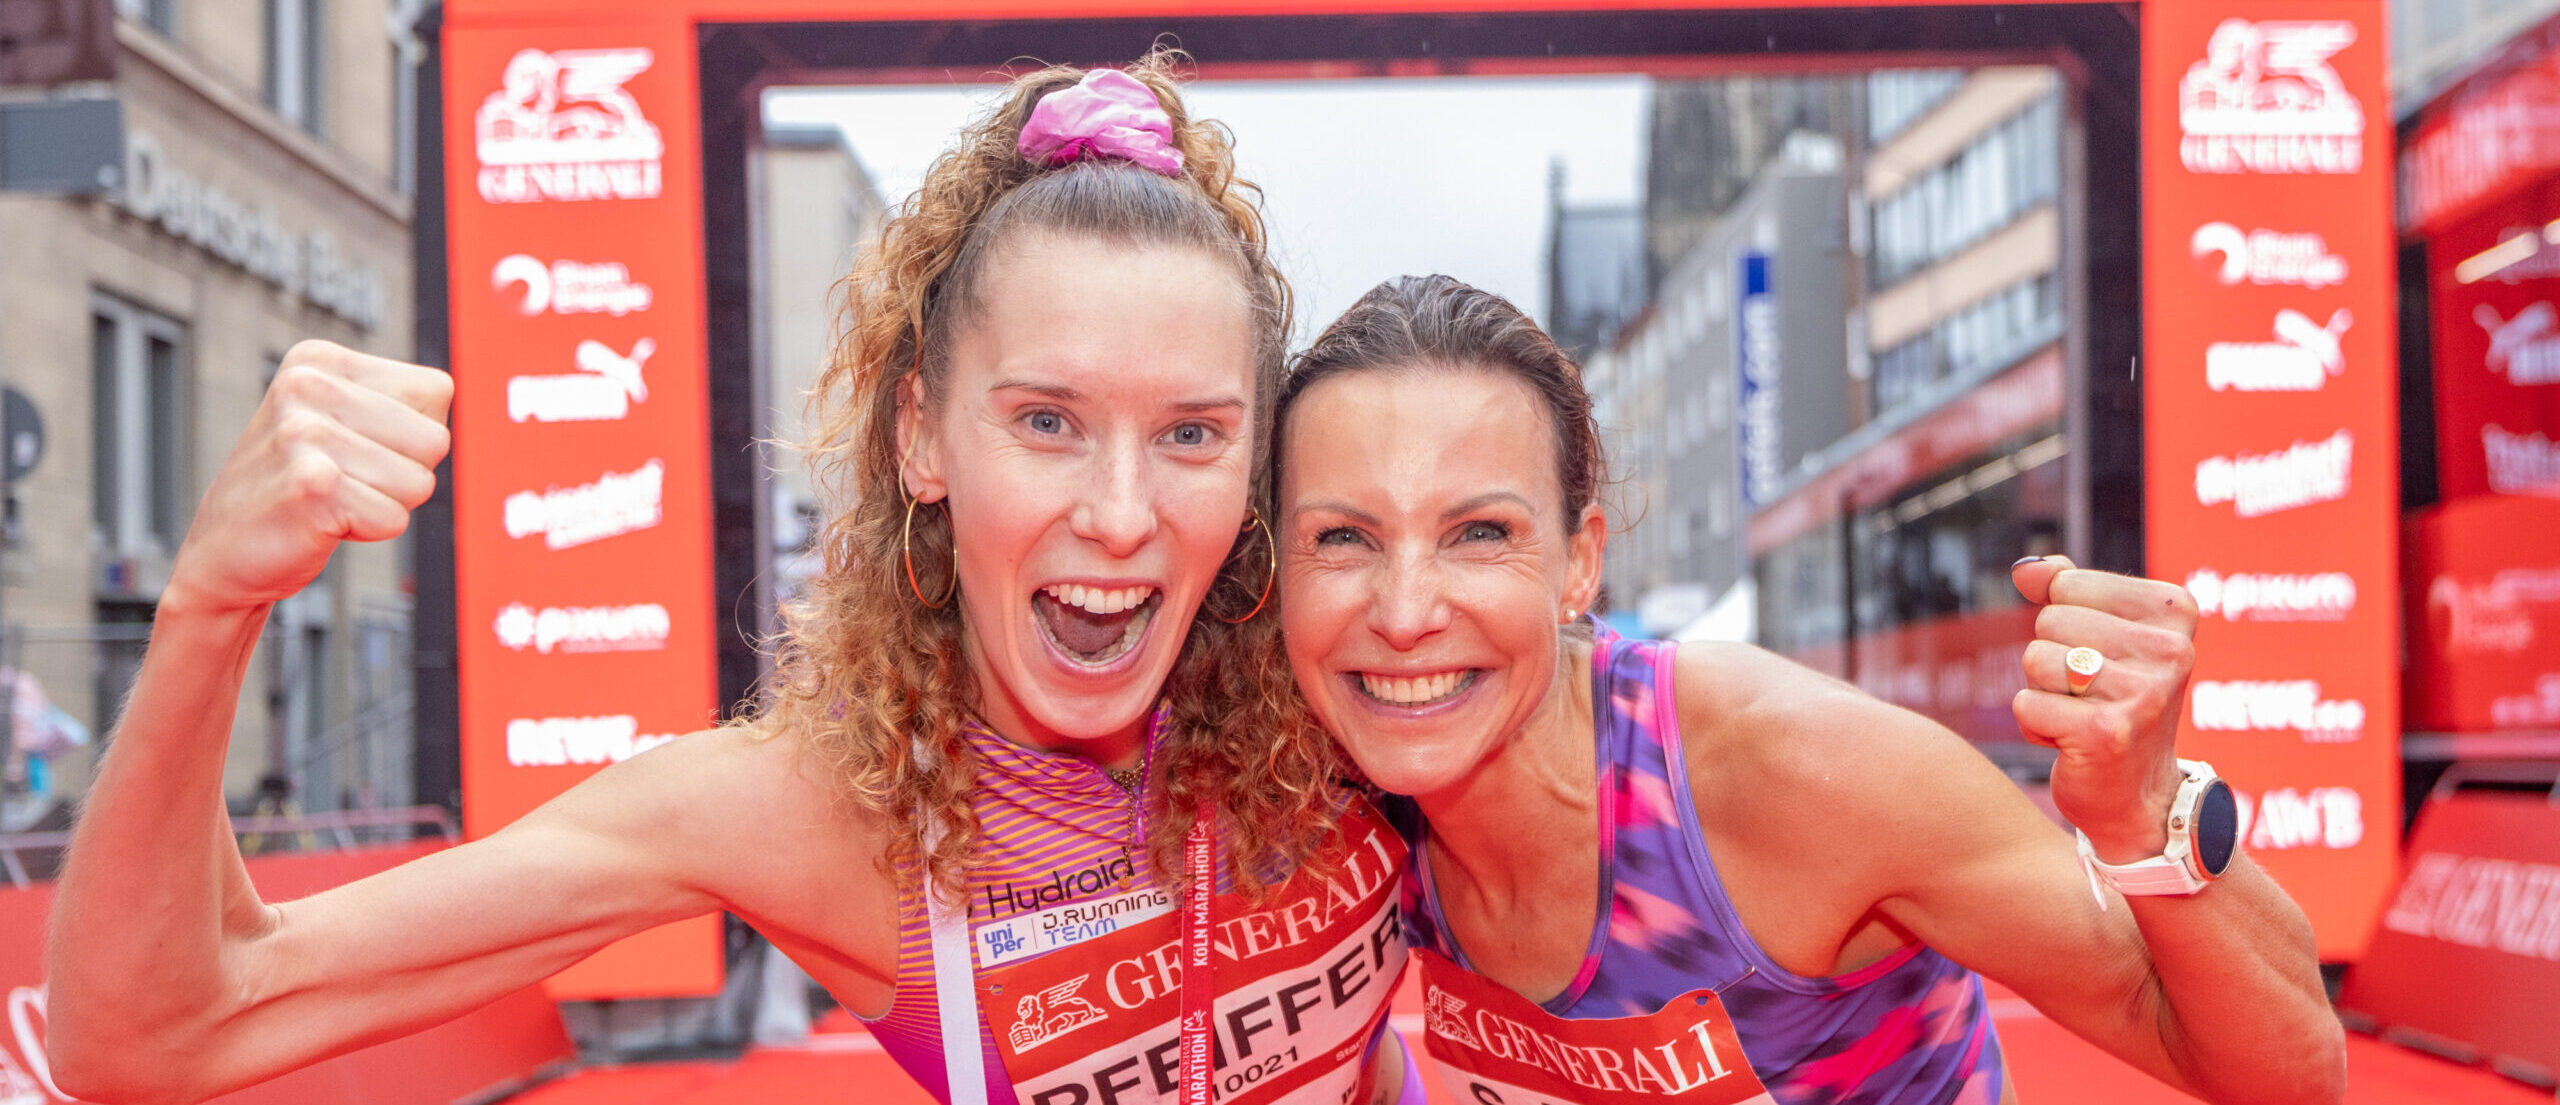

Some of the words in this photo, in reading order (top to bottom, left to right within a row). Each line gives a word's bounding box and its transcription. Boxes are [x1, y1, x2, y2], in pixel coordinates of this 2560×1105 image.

[477, 163, 662, 203] GENERALI
[986, 846, 1135, 918] Hydraid
[1194, 844, 1208, 925] MARATHON
[984, 923, 1013, 944] uni
[1044, 917, 1117, 945] TEAM
[1106, 828, 1394, 1009] GENERALI
[992, 937, 1025, 959] per
[1193, 928, 1208, 967] KÖLN
[1191, 1033, 1207, 1105] ARATHON
[1475, 1008, 1732, 1096] GENERALI
